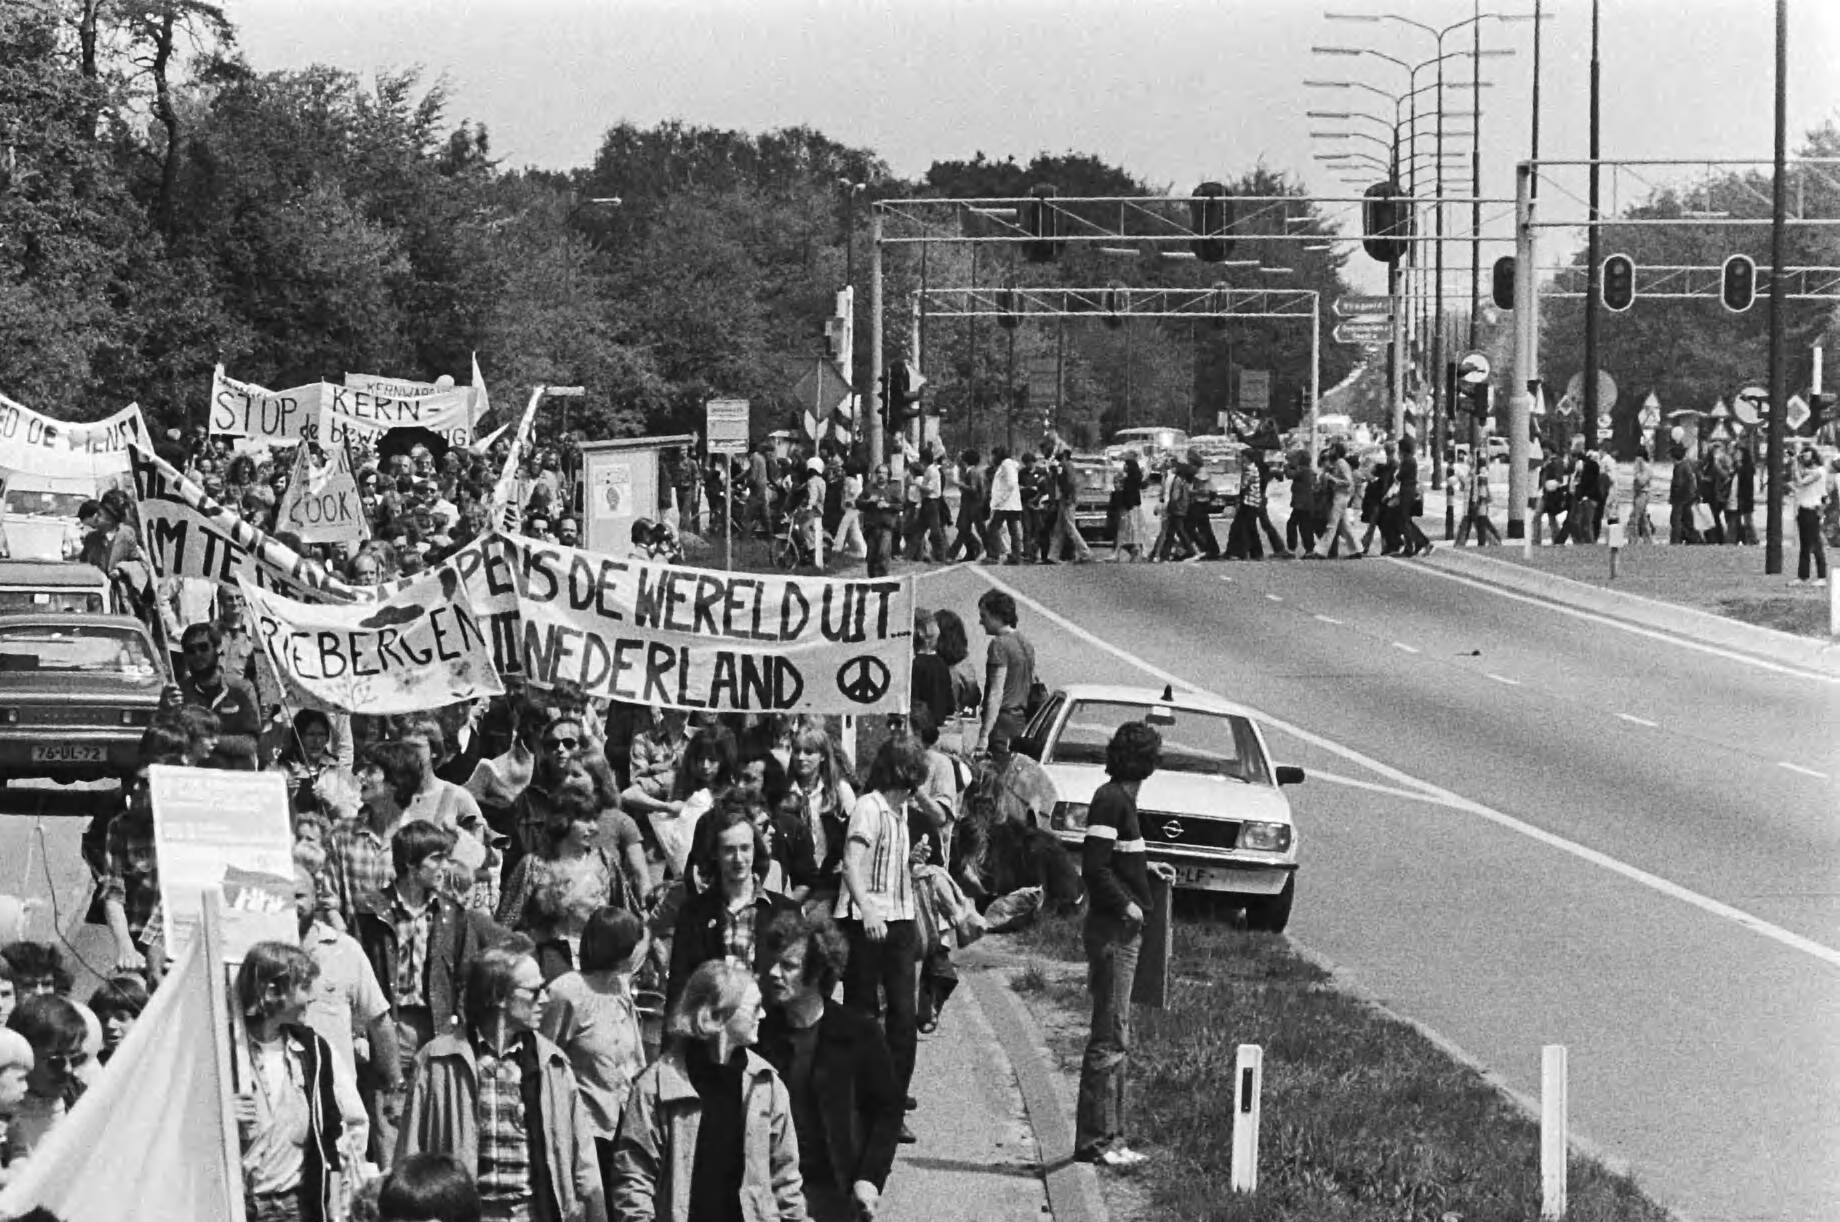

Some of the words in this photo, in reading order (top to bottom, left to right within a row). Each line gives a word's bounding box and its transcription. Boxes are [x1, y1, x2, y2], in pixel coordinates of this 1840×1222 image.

[215, 391, 298, 436] STOP
[300, 413, 320, 442] de
[332, 386, 442, 421] KERN-
[569, 554, 628, 621] DE
[634, 567, 810, 641] WERELD
[524, 620, 805, 710] NEDERLAND
